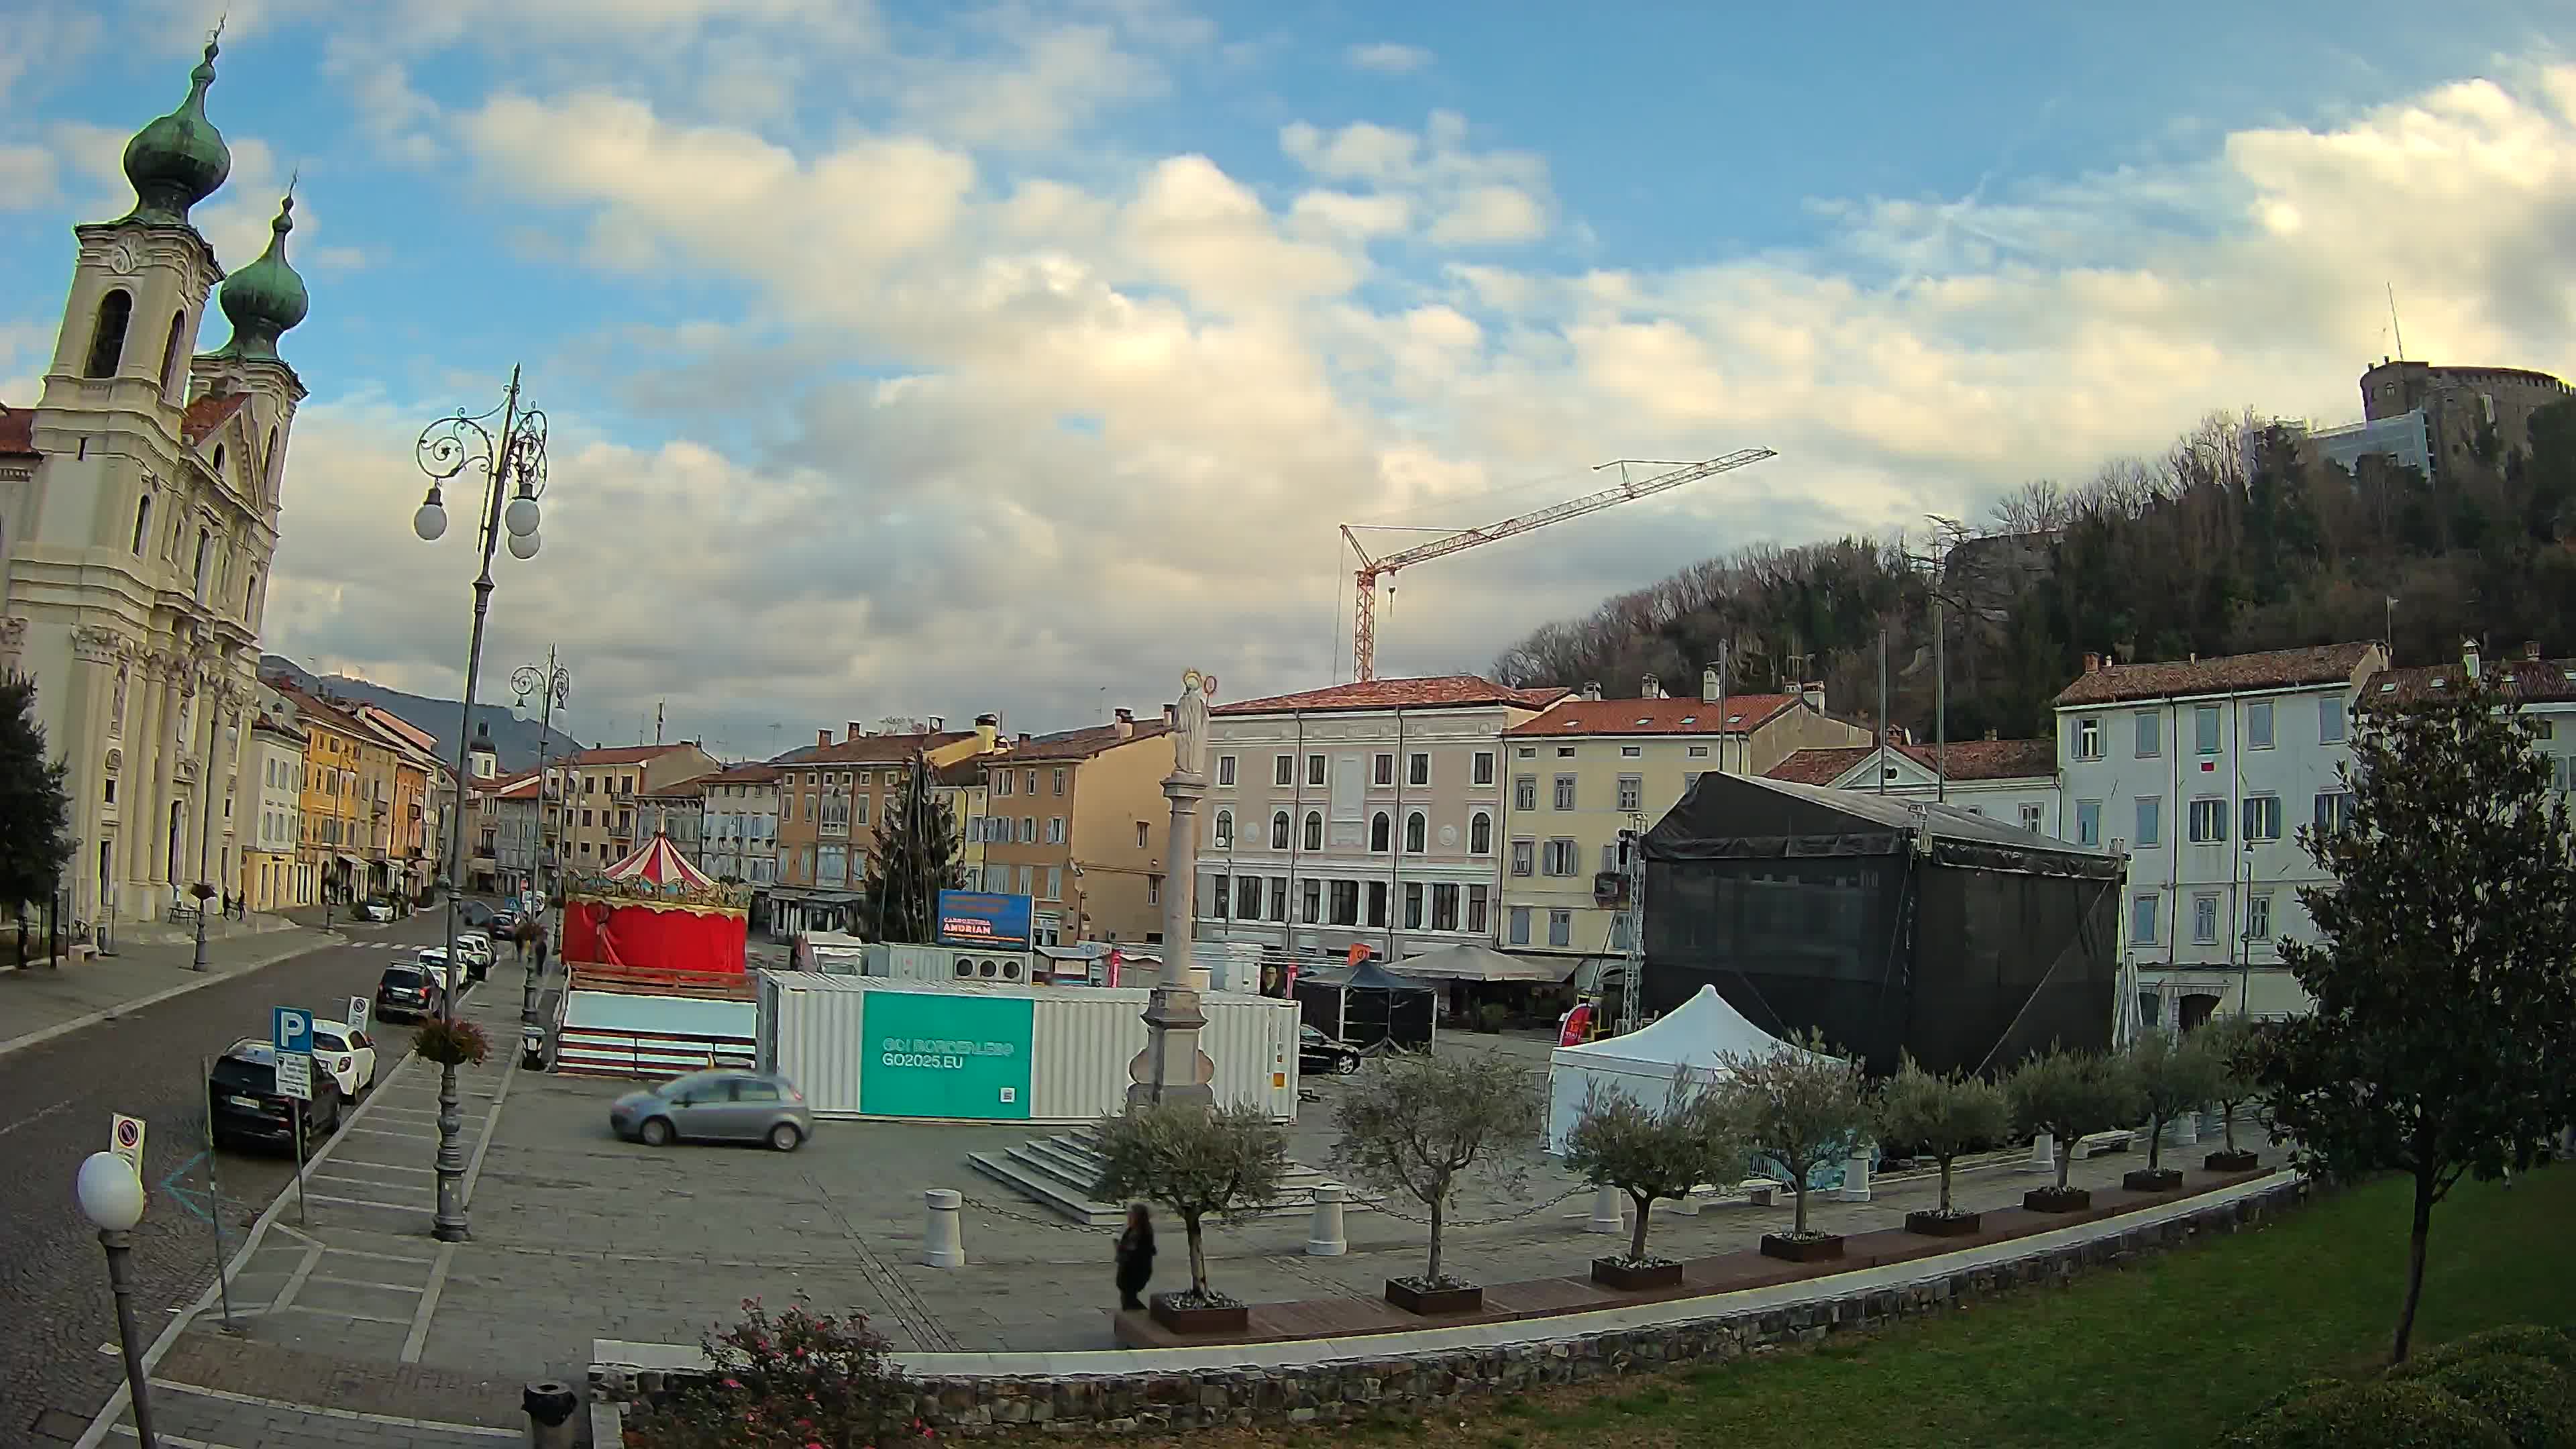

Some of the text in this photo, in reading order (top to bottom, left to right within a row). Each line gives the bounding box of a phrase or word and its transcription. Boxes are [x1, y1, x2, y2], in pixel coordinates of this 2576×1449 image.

[943, 923, 991, 934] ANDRIAN
[281, 1012, 305, 1046] P
[882, 1053, 963, 1069] GO2025.EU
